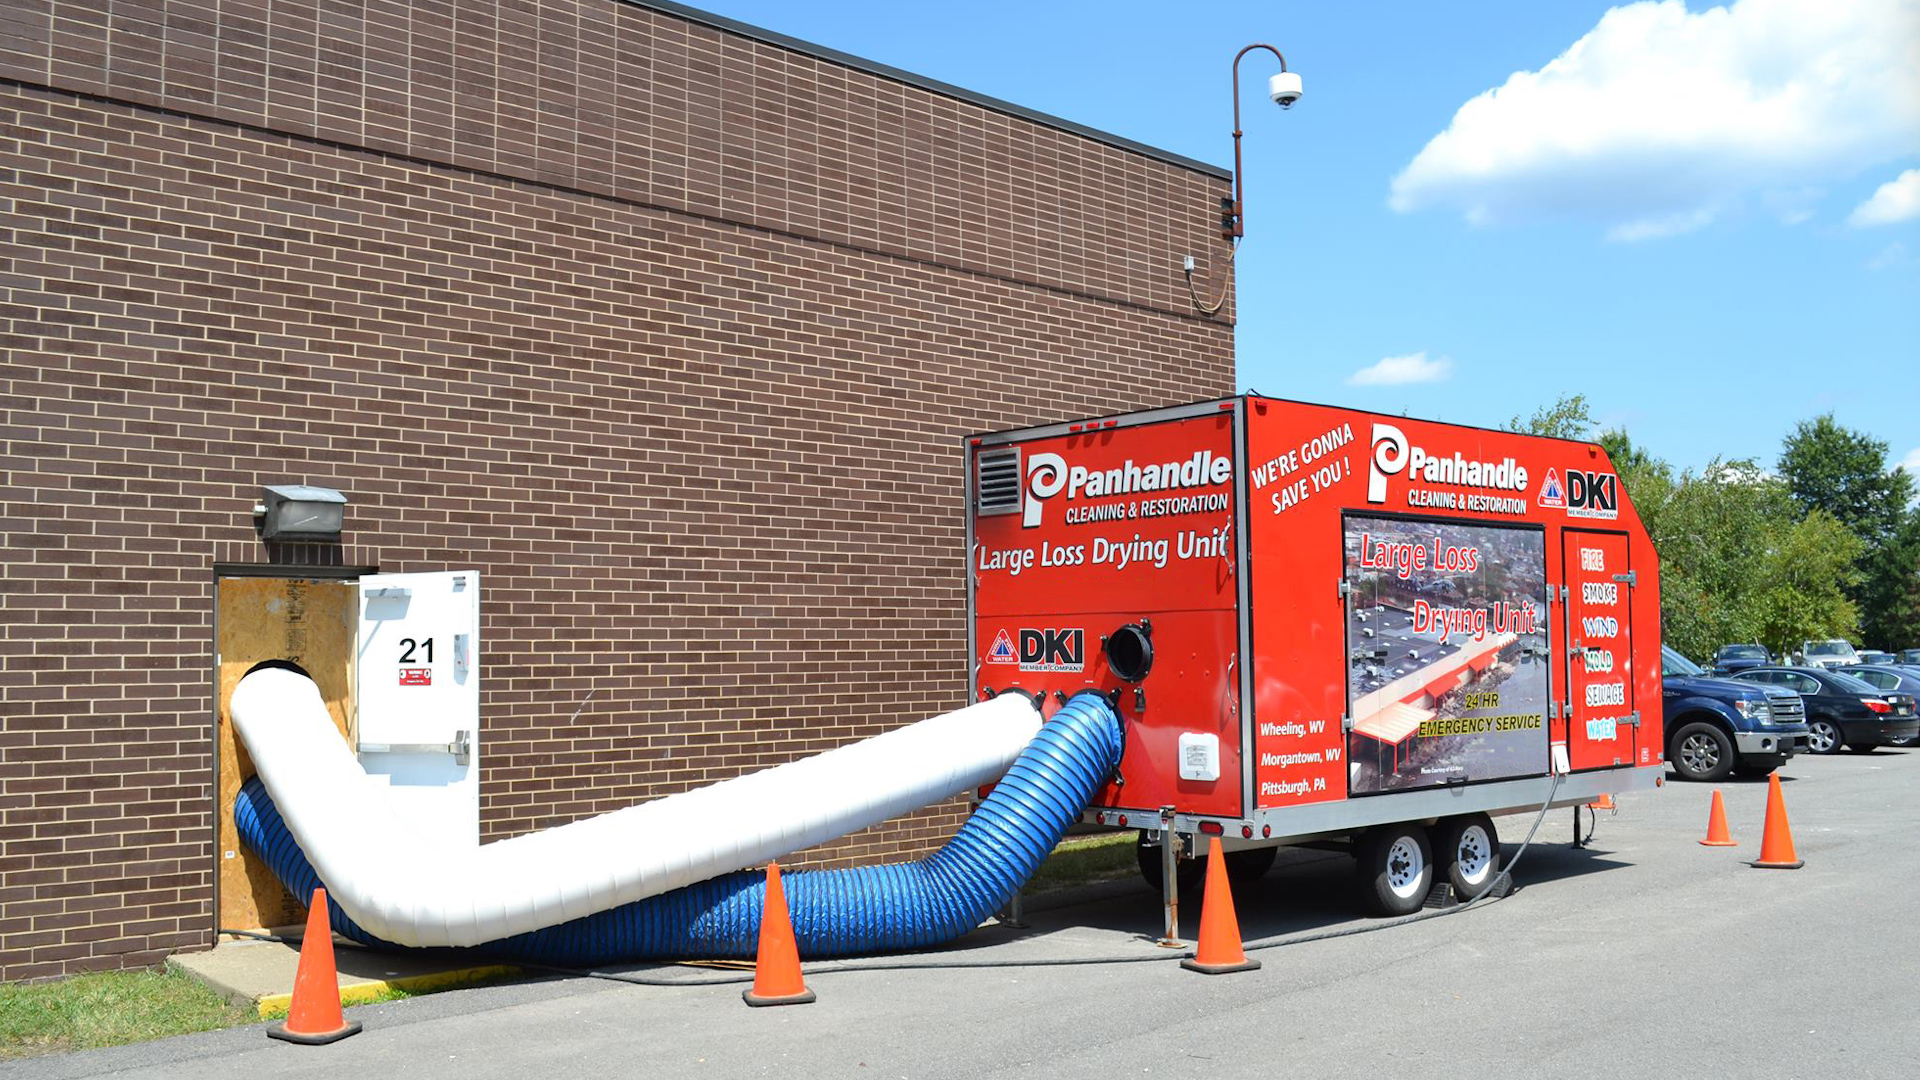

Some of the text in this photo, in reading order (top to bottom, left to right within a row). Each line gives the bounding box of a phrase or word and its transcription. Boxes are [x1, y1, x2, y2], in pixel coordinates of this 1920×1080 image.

[1251, 422, 1354, 489] WE'RE GONNA
[1408, 445, 1528, 492] Panhandle
[1067, 450, 1231, 499] Panhandle
[1271, 477, 1310, 515] SAVE
[1310, 459, 1342, 493] YOU
[1407, 488, 1527, 515] CLEANING & RESTORATION
[1566, 469, 1617, 511] DKI
[1065, 493, 1228, 524] CLEANING & RESTORATION
[979, 527, 1228, 575] Large Loss Drying Unit
[1360, 532, 1478, 580] Large Loss
[1580, 548, 1604, 571] FIRE
[1582, 582, 1618, 606] SMOKE
[1412, 599, 1536, 644] Drying Unit
[1582, 616, 1618, 638] WIND
[398, 637, 433, 663] 21
[1020, 628, 1084, 664] DKI
[1584, 650, 1613, 674] MOLD
[1465, 692, 1499, 711] 24 HR
[1585, 683, 1625, 707] SEWAGE
[1260, 720, 1325, 738] Wheeling, WV
[1418, 714, 1542, 737] EMERGENCY SERVICE
[1586, 716, 1616, 742] WATER
[1260, 748, 1342, 769] Morgantown, WV
[1260, 777, 1326, 796] Pittsburgh, PA
